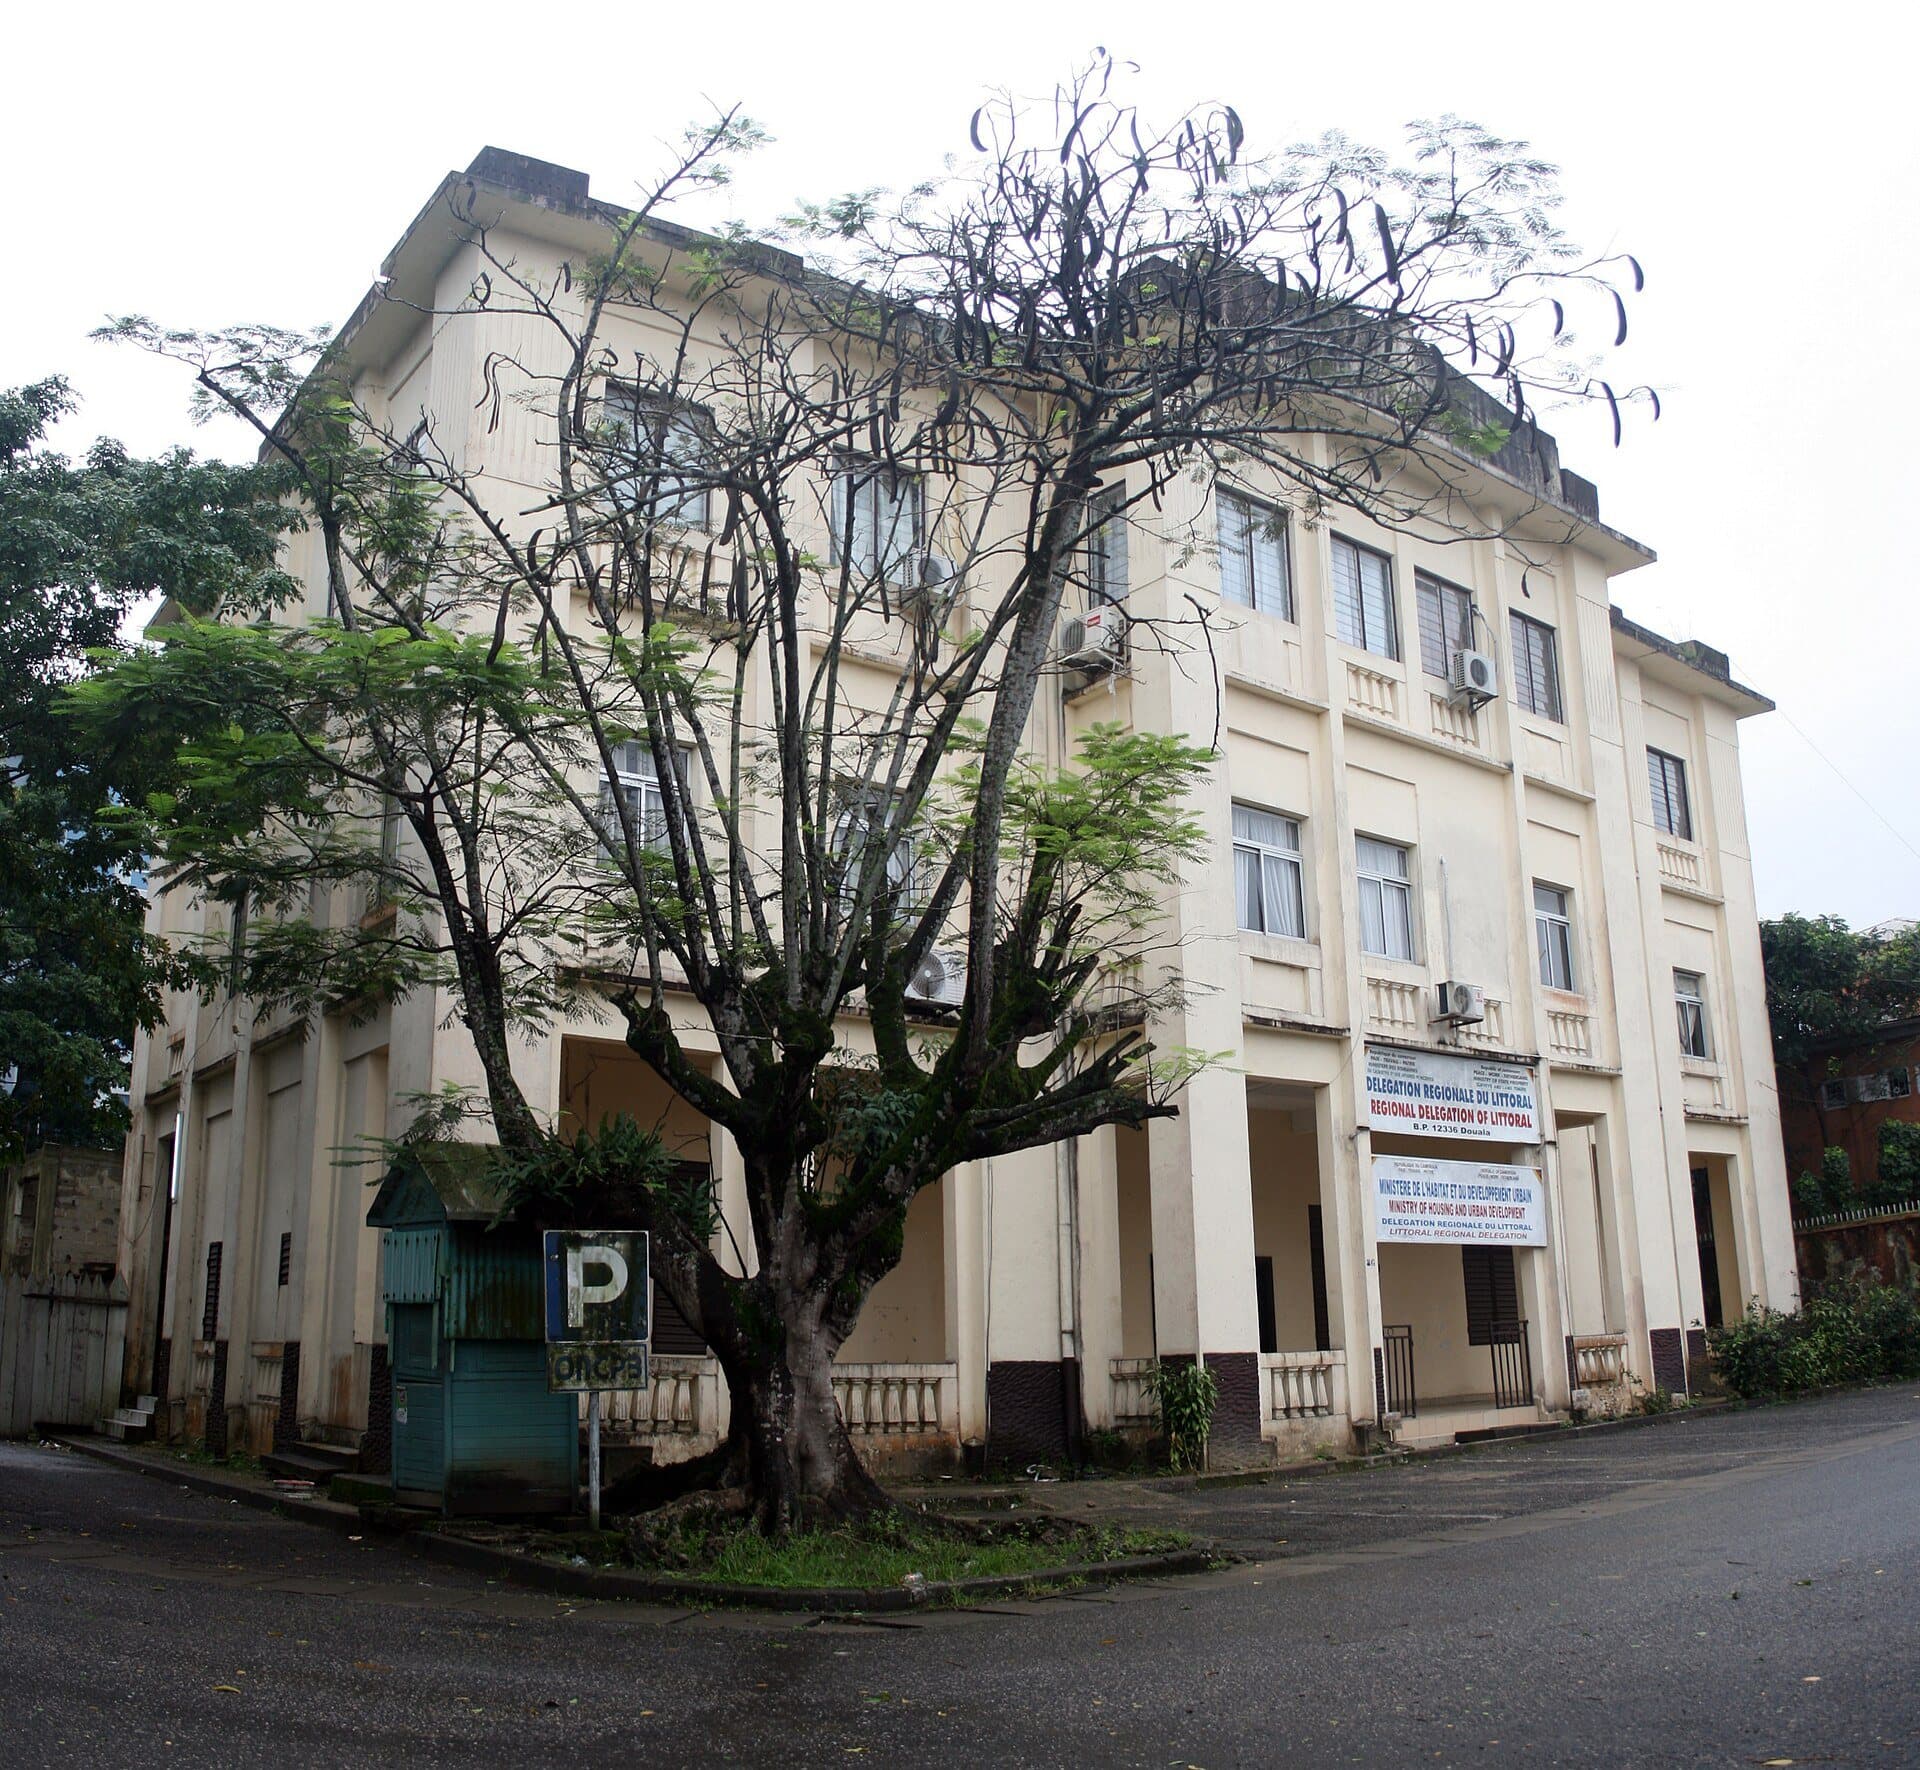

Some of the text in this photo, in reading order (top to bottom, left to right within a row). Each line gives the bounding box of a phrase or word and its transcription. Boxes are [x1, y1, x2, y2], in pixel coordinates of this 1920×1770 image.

[1367, 1076, 1532, 1109] DELEGATION REGIONALE DU LITTORAL
[1371, 1099, 1532, 1128] REGIONAL DELEGATION OF LITTORAL
[1413, 1123, 1490, 1136] B.P. 12336 Douala
[1379, 1178, 1532, 1203] MINISTERE DE L'HABITAT ET DU DEVELOPPEMENT URBAIN
[1389, 1200, 1525, 1219] MINISTRY OF HOUSING AND URBAN DEVELOPMENT
[1382, 1218, 1435, 1227] DELEGATION
[1438, 1221, 1483, 1229] REGIONALE
[1390, 1228, 1432, 1236] LITTORAL
[1434, 1230, 1476, 1238] REGIONAL
[567, 1246, 628, 1327] P
